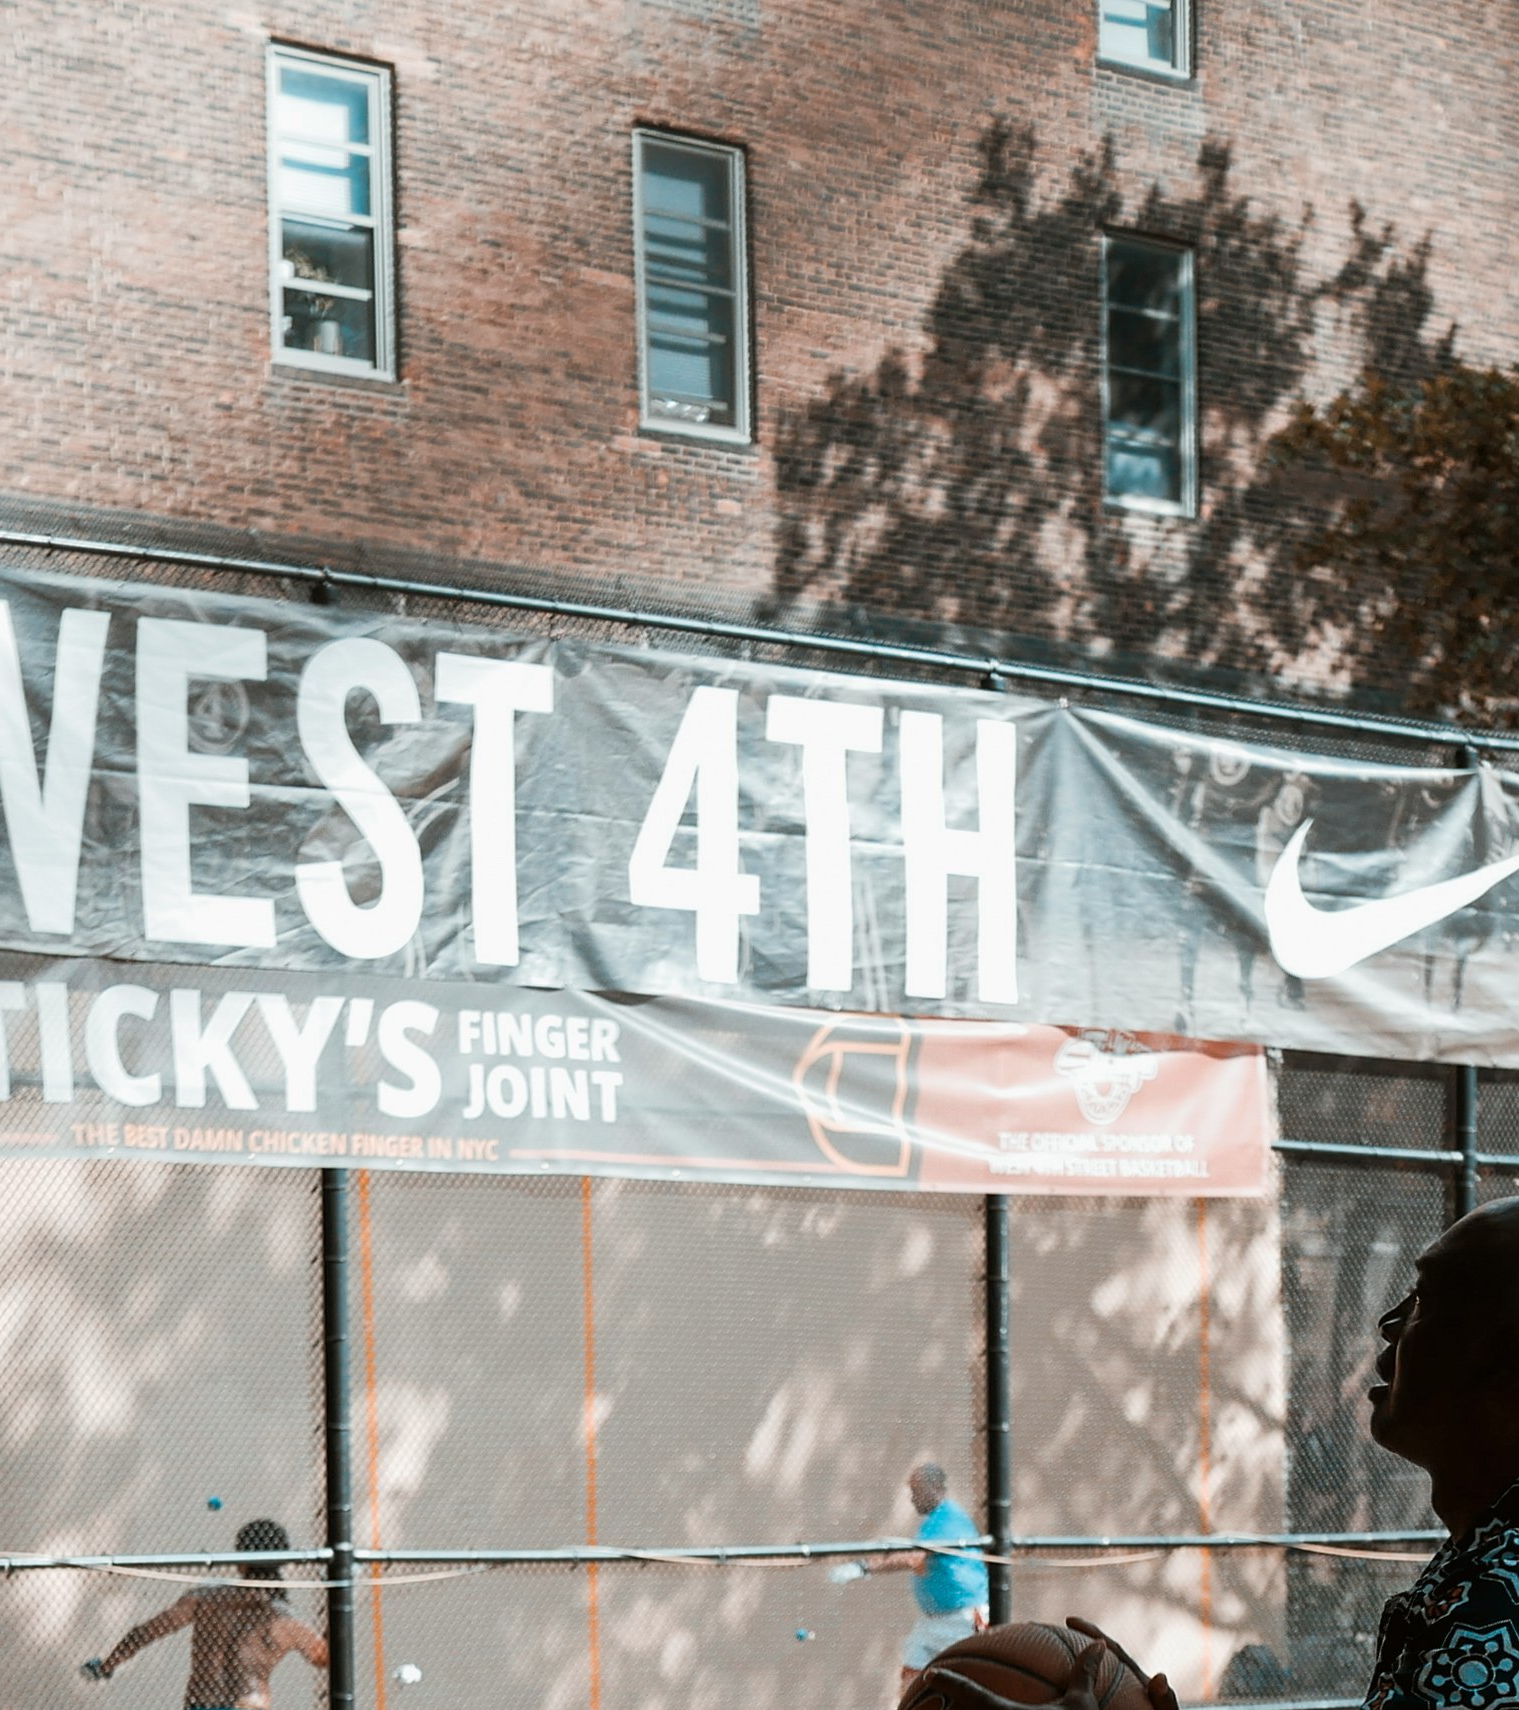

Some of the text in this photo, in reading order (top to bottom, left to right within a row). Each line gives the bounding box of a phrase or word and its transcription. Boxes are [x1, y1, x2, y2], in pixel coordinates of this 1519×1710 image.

[628, 686, 1019, 1006] 4TH
[458, 1009, 621, 1063] FINGER
[461, 1065, 624, 1123] JOINT
[71, 1123, 500, 1162] THE BEST DAMN CHICKEN FINGER IN NYC
[998, 1131, 1030, 1151] THE
